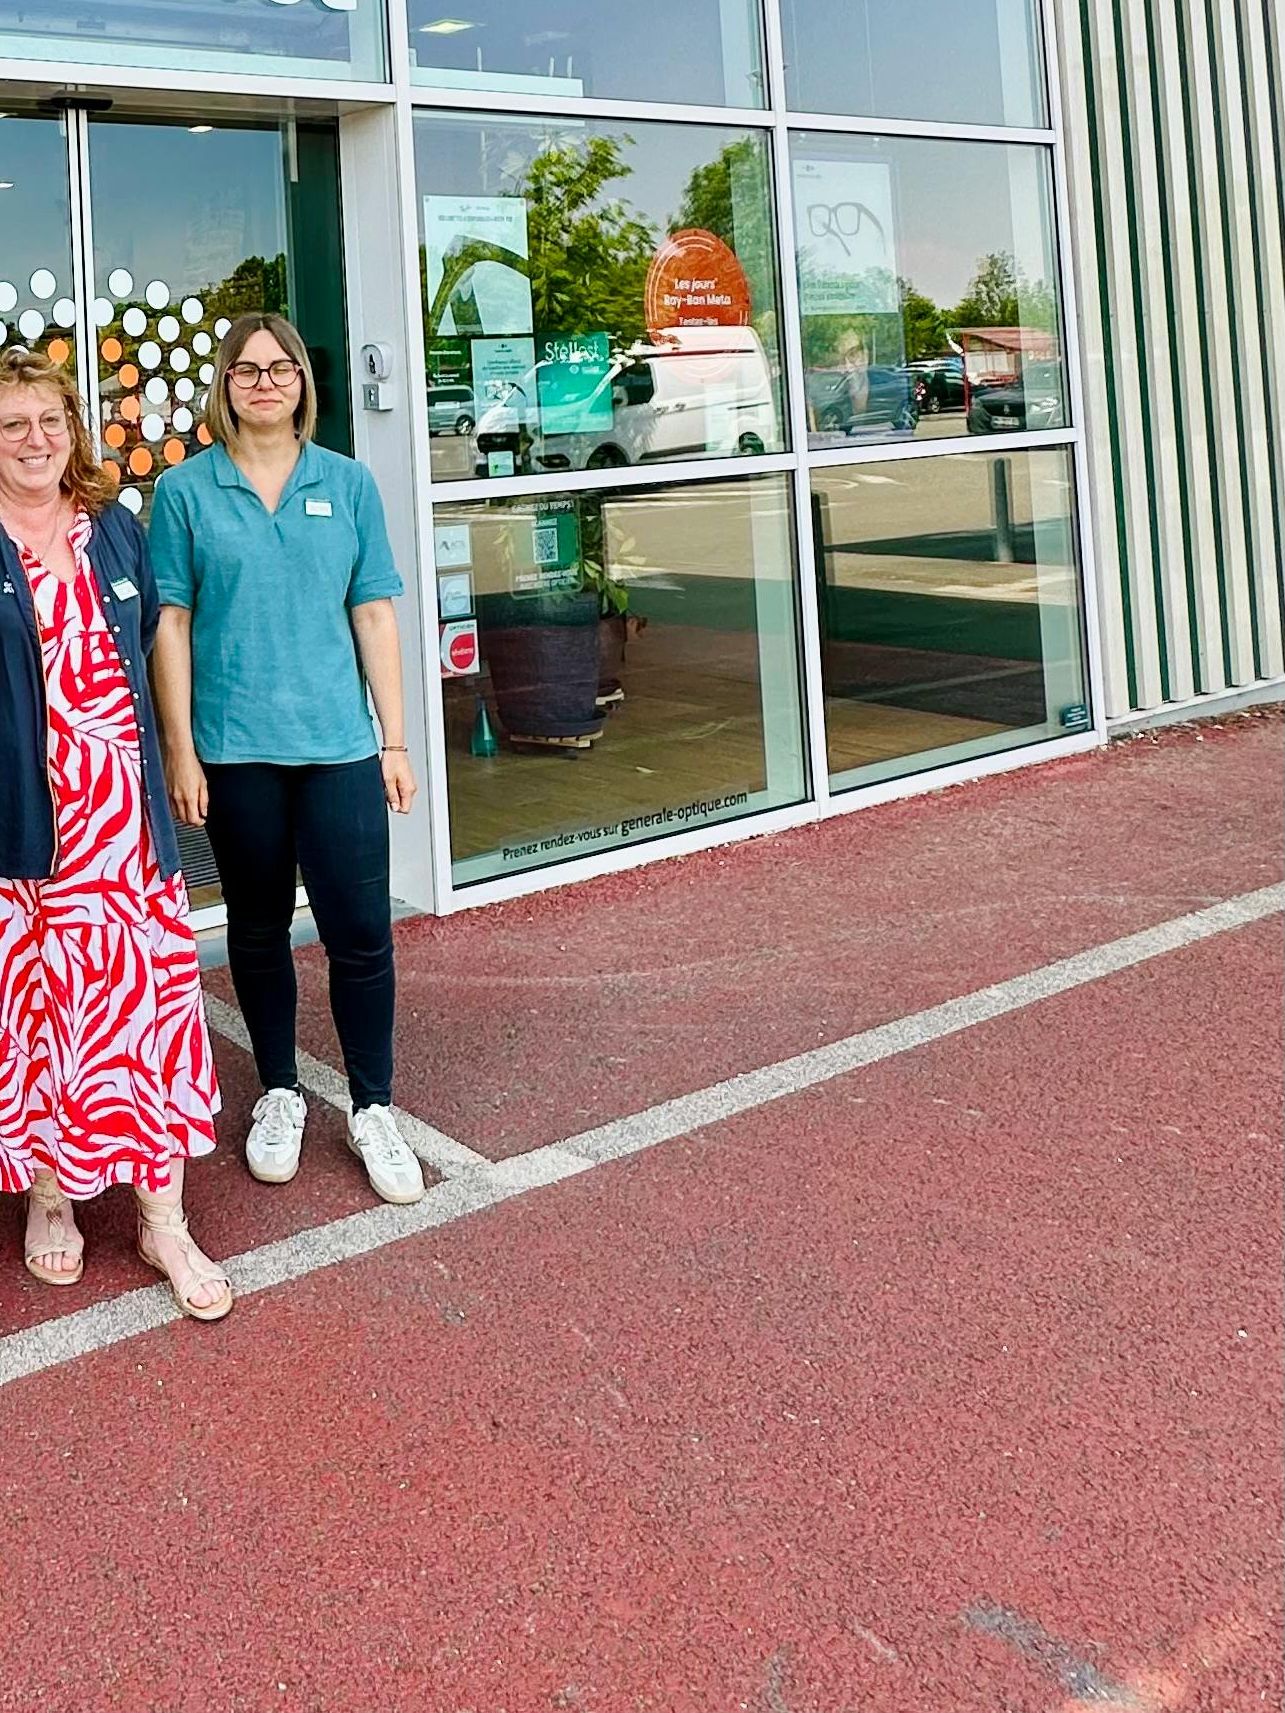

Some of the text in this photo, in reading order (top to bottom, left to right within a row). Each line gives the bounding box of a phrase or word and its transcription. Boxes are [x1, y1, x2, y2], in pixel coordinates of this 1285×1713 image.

[502, 791, 748, 861] Prenez rendez-vous sur generale-optique.com
